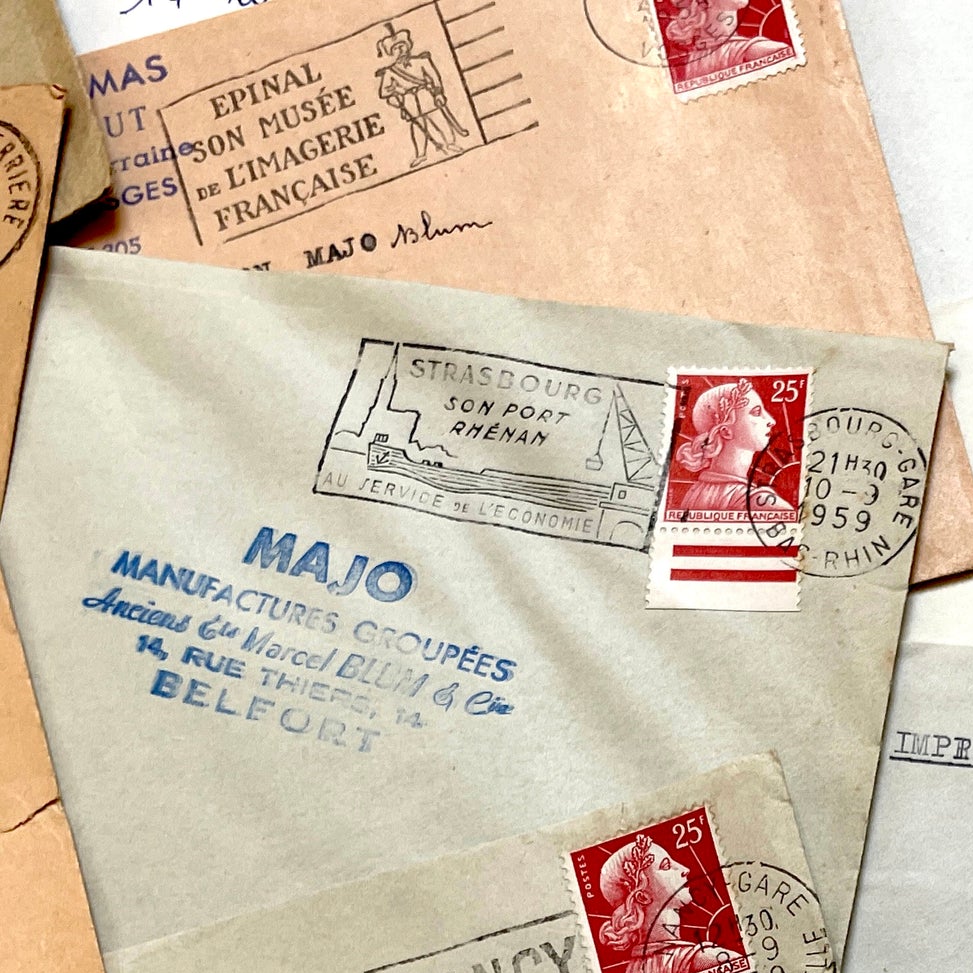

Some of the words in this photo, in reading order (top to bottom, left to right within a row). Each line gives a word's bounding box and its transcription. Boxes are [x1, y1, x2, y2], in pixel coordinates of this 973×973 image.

[210, 63, 323, 119] EPINAL
[193, 125, 247, 163] SON
[258, 85, 357, 138] MUSÉE
[196, 182, 222, 202] DE
[225, 112, 386, 190] L'IMAGERIE
[213, 154, 378, 233] FRANÇAISE
[303, 232, 378, 269] MAJO
[409, 359, 604, 406] STRASBOURG
[443, 395, 496, 416] SON
[502, 403, 571, 426] PORT
[449, 419, 550, 447] RHÉNAN
[322, 471, 349, 489] AU
[358, 476, 444, 510] SERVICE
[667, 510, 736, 523] REPUBLIQUE
[800, 502, 871, 533] 1959
[242, 526, 417, 603] MAJO
[111, 549, 341, 634] MANUFACTURES
[353, 619, 518, 683] GROUPÉES
[181, 646, 248, 680] RUE
[240, 626, 339, 673] Marcel
[336, 651, 430, 699] BLUM
[150, 668, 382, 753] BELFORT
[577, 854, 594, 899] POSTES
